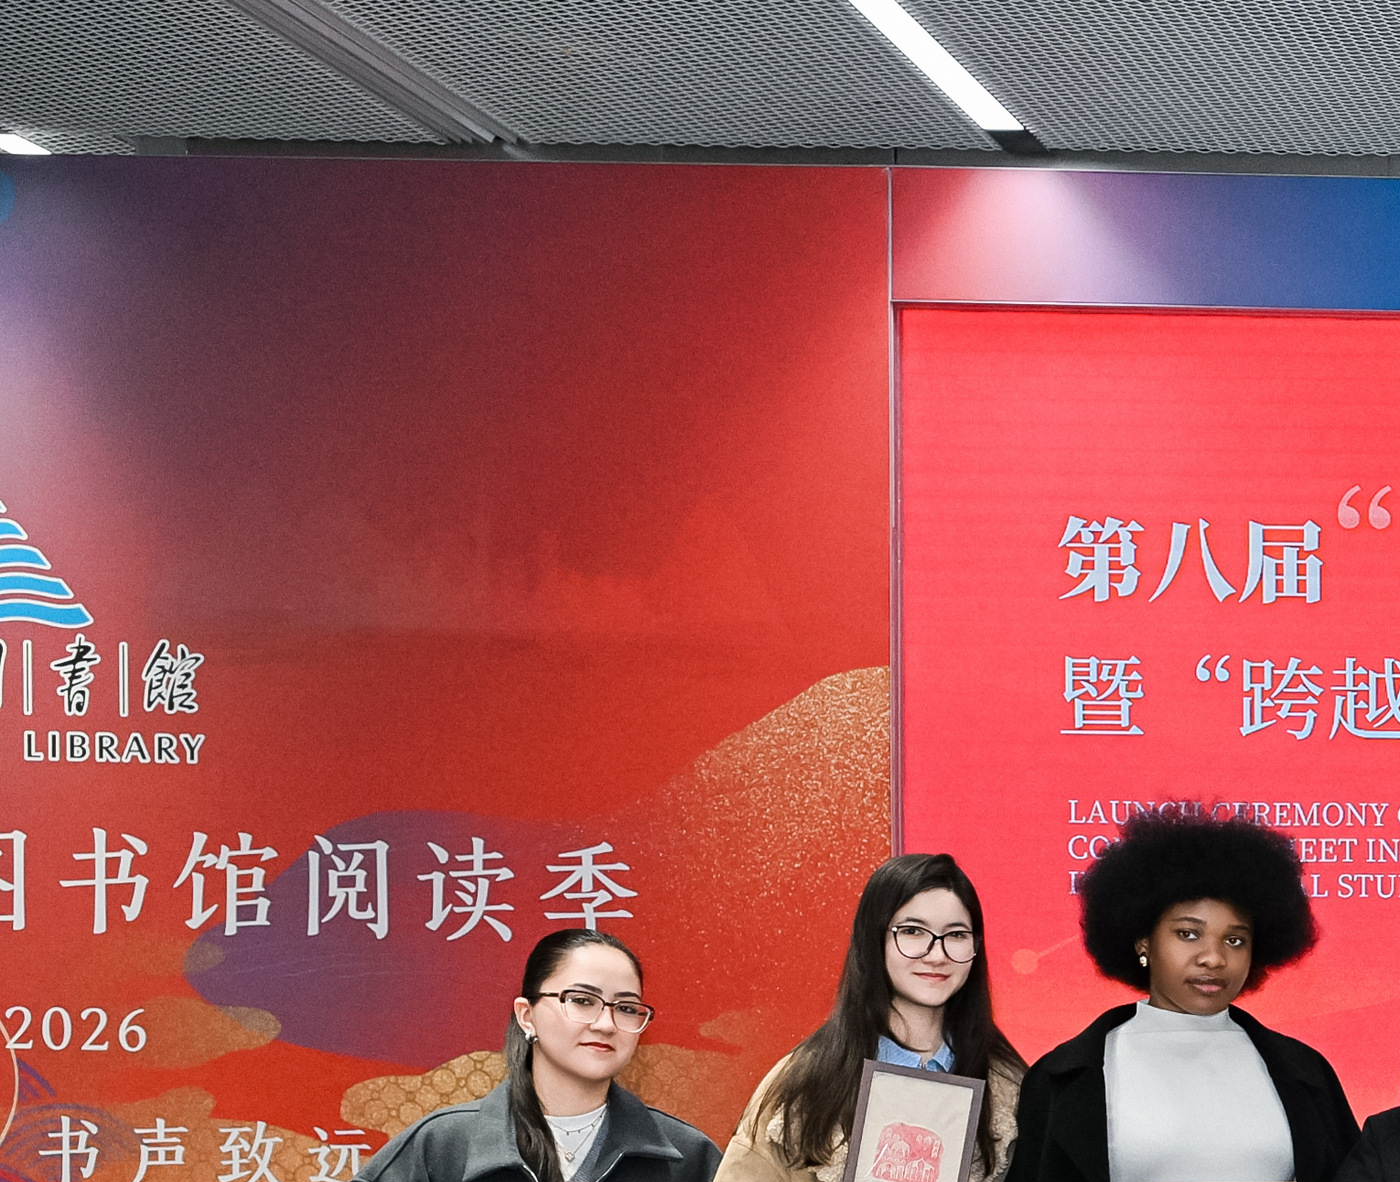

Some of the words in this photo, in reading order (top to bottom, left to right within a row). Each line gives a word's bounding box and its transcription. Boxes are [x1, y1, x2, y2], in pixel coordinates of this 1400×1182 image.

[25, 731, 205, 763] LIBRARY
[1212, 802, 1389, 827] CEREMONY
[1291, 838, 1358, 863] EET
[1366, 839, 1400, 863] IN
[0, 827, 638, 941] 书馆阅读季
[5, 1006, 148, 1052] 2026
